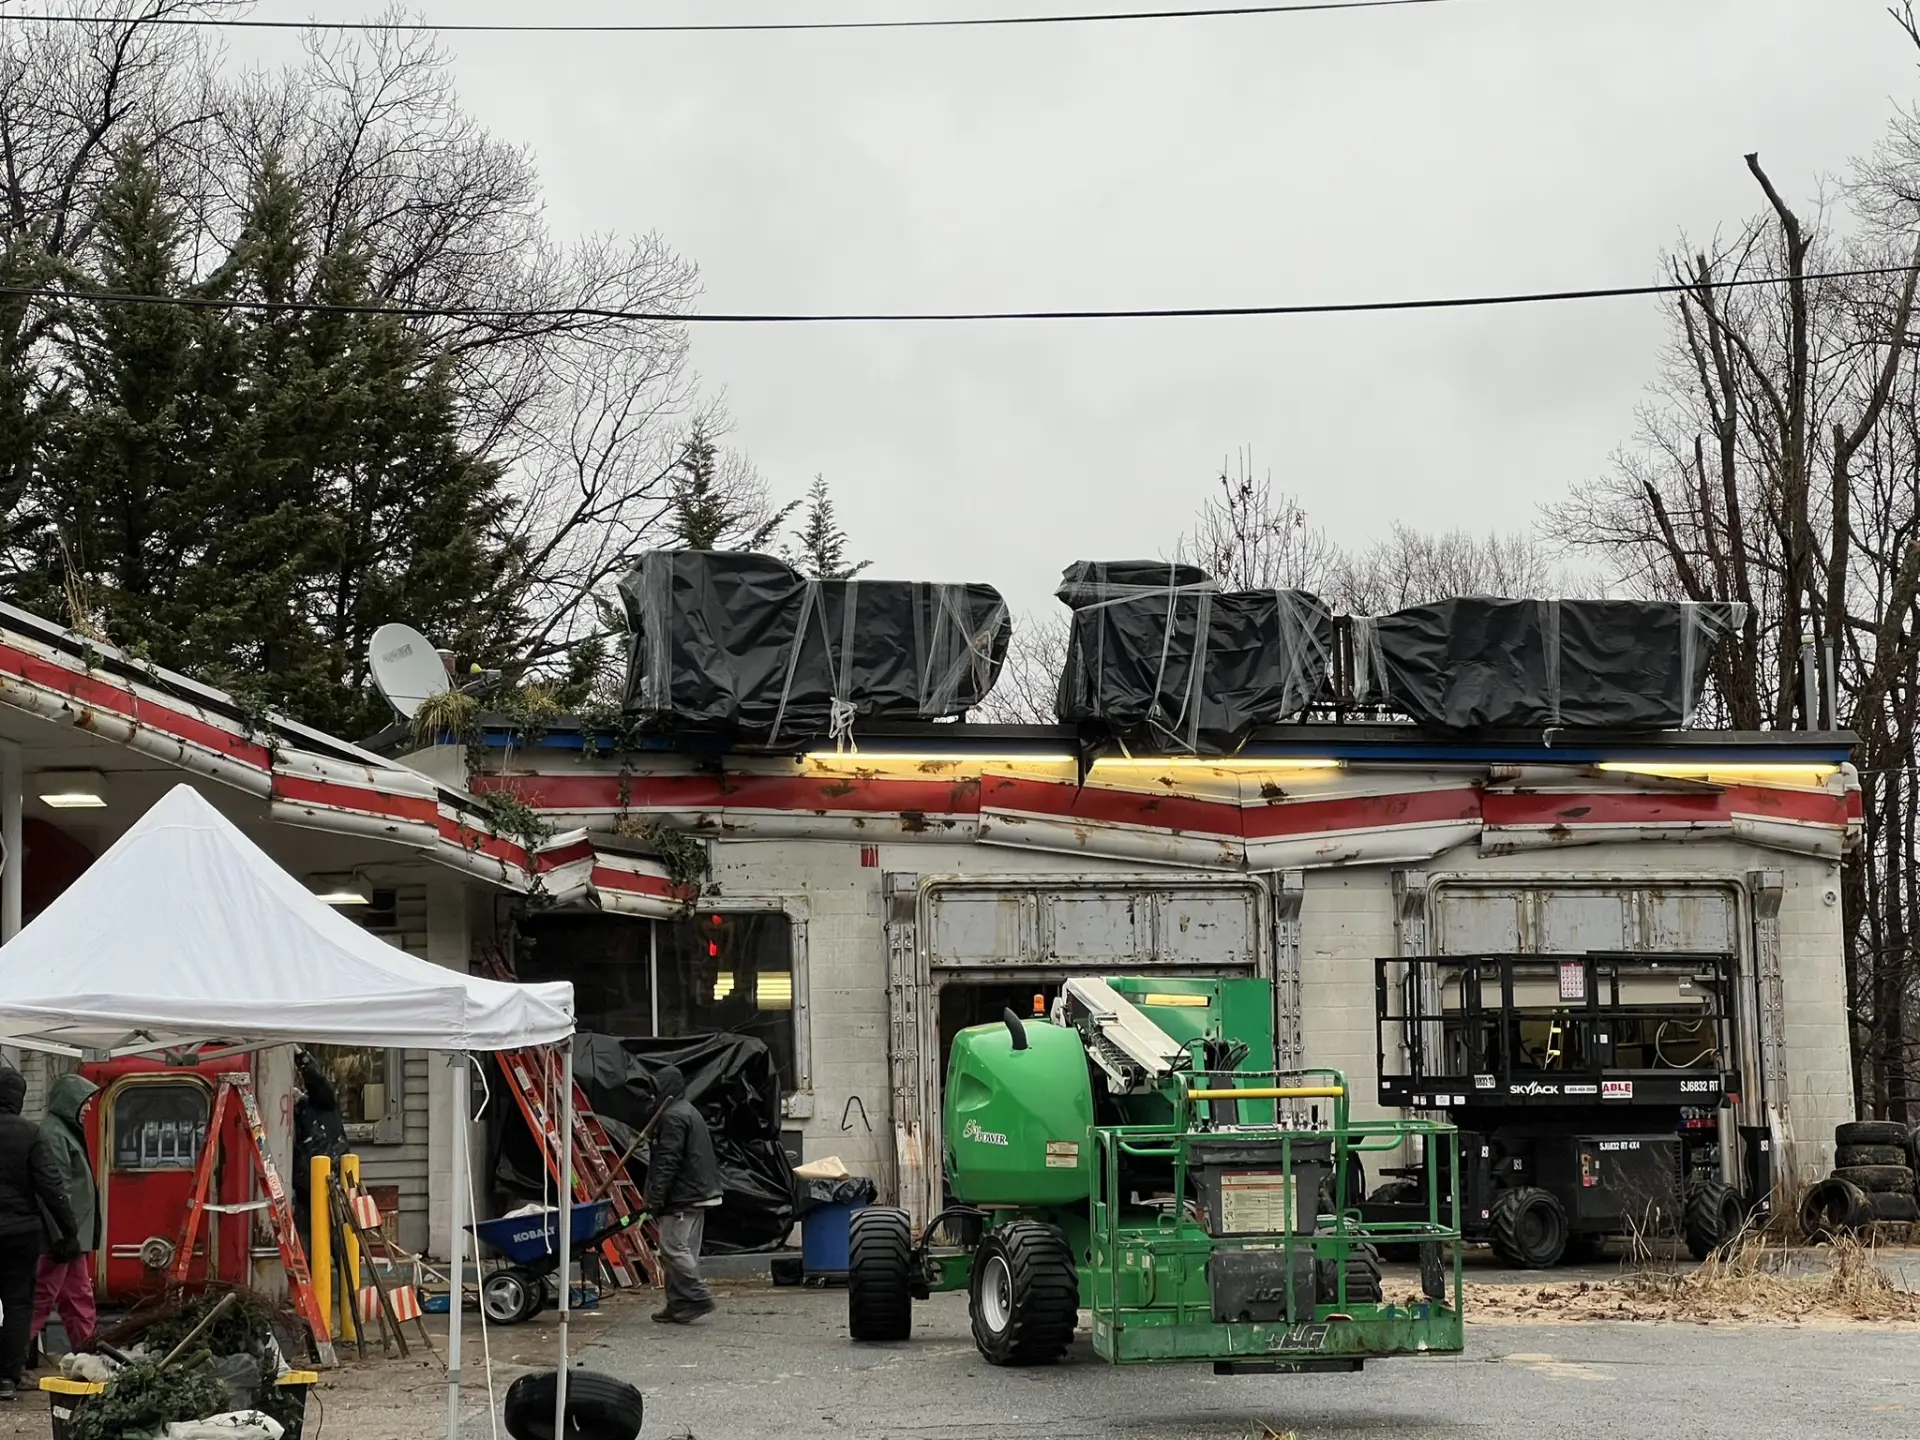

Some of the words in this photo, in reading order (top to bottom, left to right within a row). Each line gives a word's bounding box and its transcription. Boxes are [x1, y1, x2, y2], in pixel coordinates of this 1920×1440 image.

[1510, 1081, 1559, 1096] SKYJACK
[1602, 1083, 1631, 1093] ABLE
[1680, 1081, 1707, 1092] SJ6832
[1709, 1080, 1719, 1091] RT
[513, 1226, 555, 1243] KOBALT
